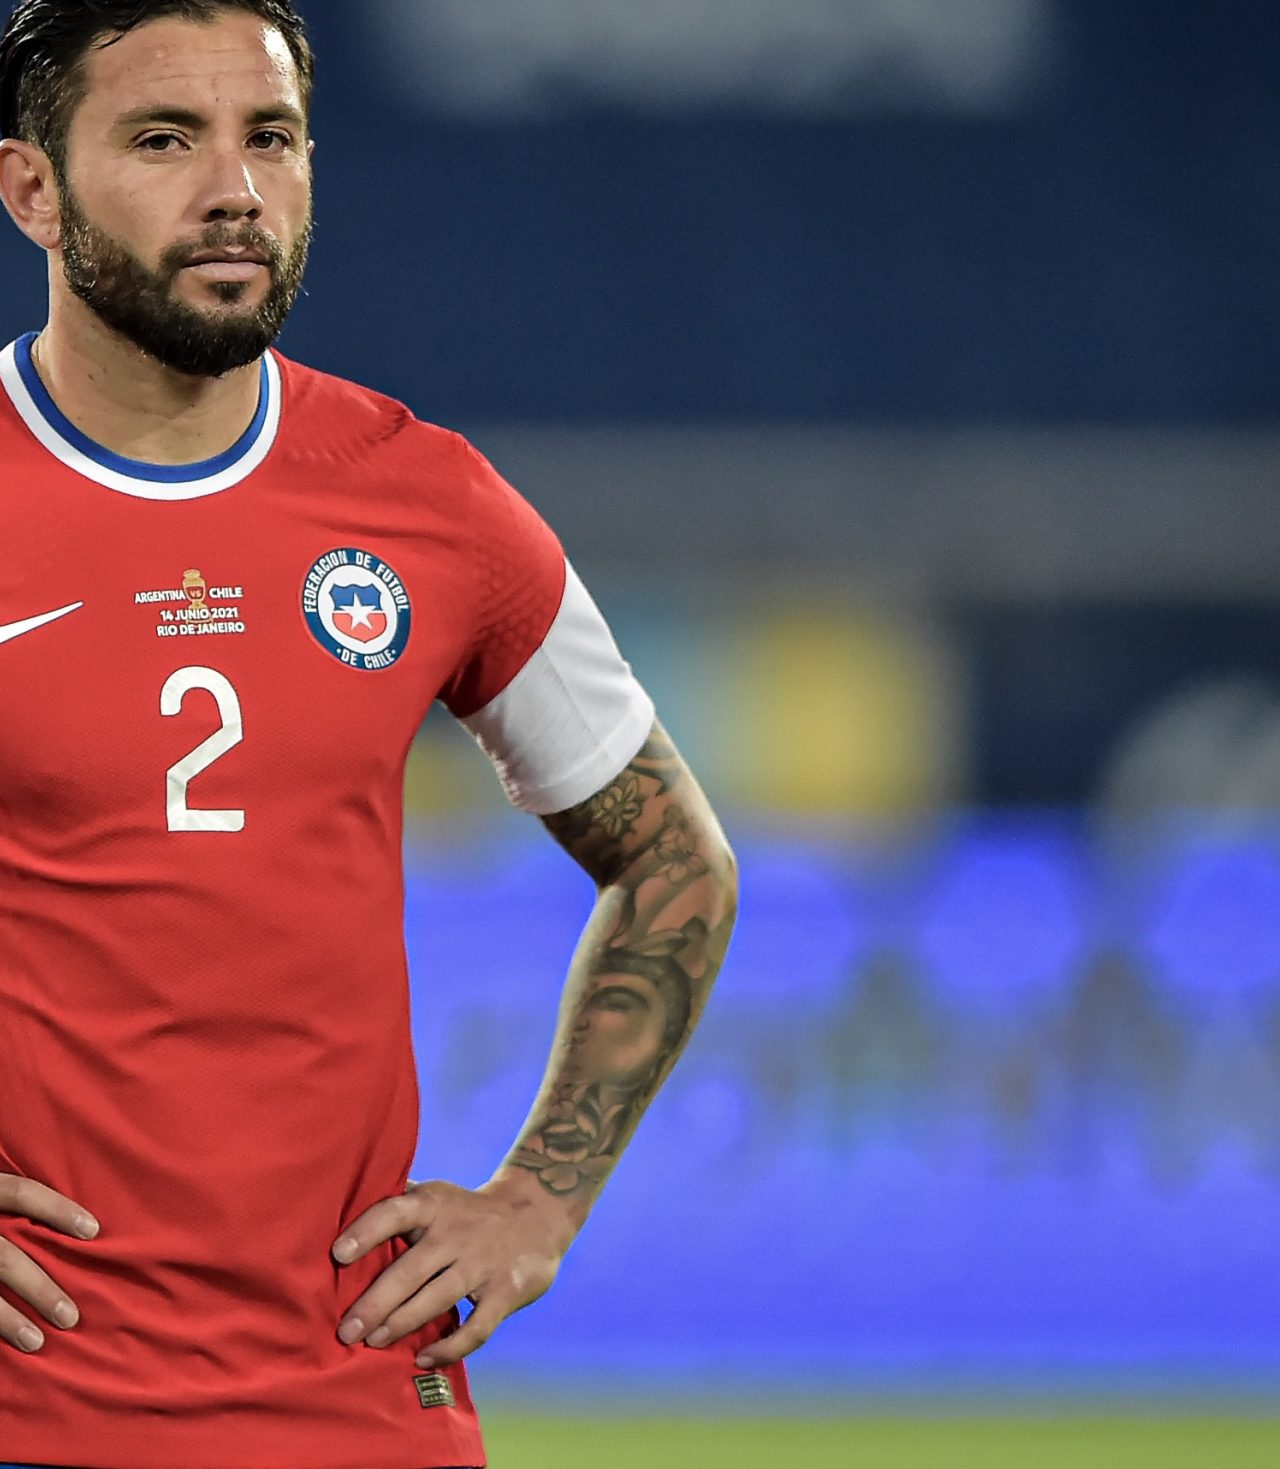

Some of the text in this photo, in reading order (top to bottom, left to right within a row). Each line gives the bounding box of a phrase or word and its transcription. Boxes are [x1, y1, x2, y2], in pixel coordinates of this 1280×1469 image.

[304, 550, 410, 612] FEDERACION DE FUTBOL
[134, 589, 186, 604] ARGENTINA
[209, 586, 243, 598] CHILE
[160, 607, 238, 621] 14 JUNIO 2021
[157, 621, 245, 637] RIO DE JANEIRO
[341, 648, 396, 669] DE CHILE
[160, 665, 245, 832] 2
